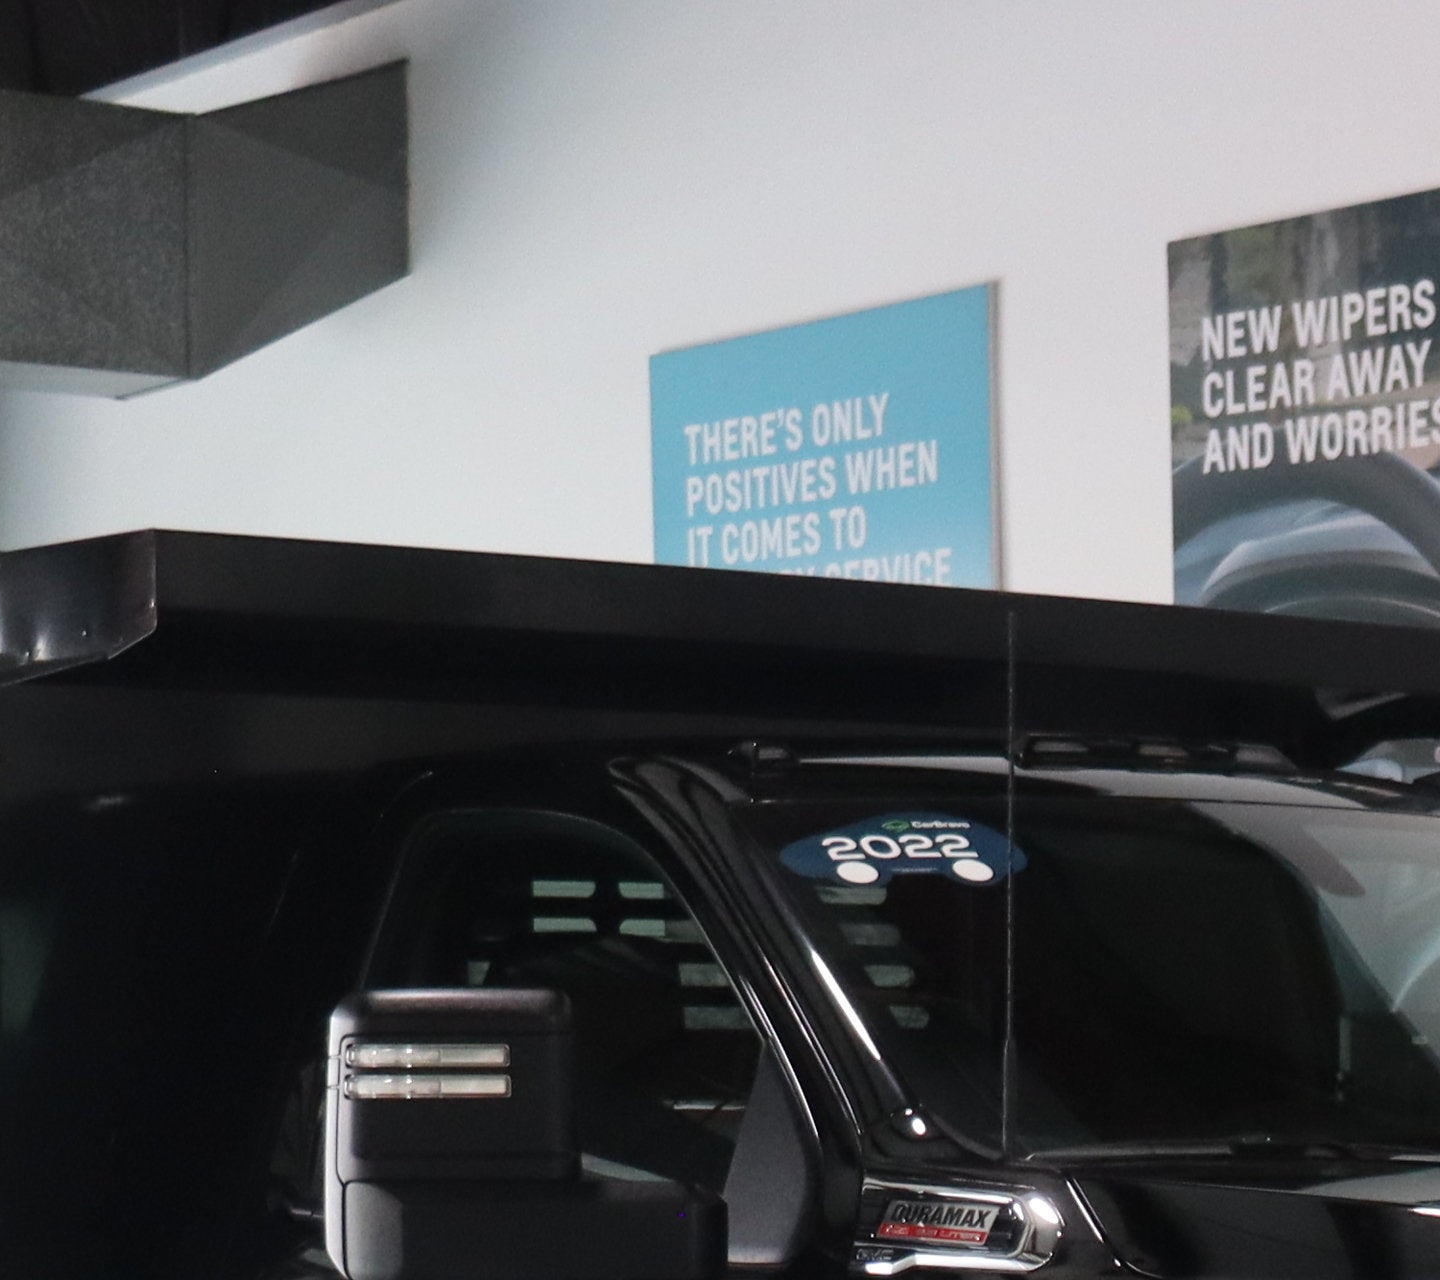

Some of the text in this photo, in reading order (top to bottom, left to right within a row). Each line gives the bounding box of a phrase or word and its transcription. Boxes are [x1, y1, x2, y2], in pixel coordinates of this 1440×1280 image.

[1202, 279, 1436, 362] NEW WIPERS
[1202, 358, 1315, 419] CLEAR
[1328, 338, 1432, 402] AWAY
[684, 393, 890, 466] THERE'S ONLY
[1202, 422, 1274, 475] AND
[686, 440, 939, 517] POSITIVES WHEN
[687, 505, 867, 569] IT COMES TO
[821, 834, 980, 861] 2022
[891, 1202, 992, 1230] DURAMAX
